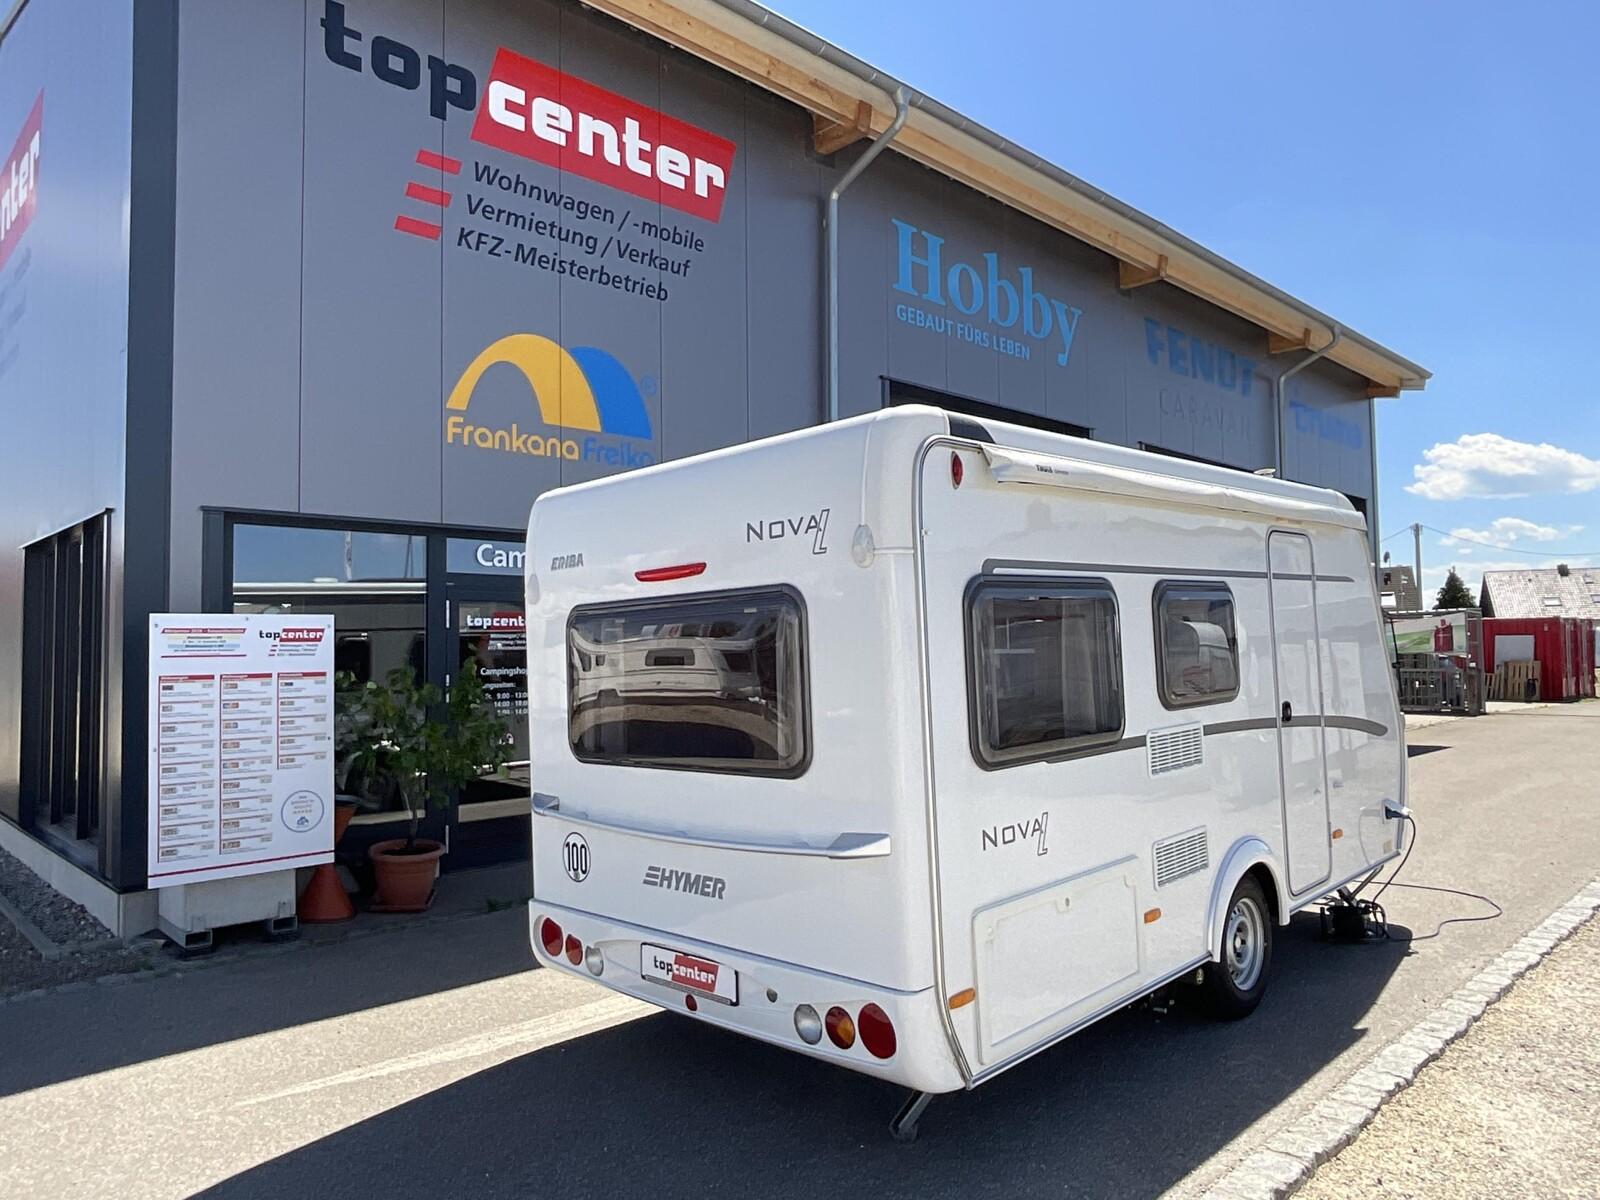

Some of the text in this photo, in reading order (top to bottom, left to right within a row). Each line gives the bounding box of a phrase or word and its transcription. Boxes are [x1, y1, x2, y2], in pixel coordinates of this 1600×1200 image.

[474, 161, 615, 224] Wohnwagen
[467, 194, 598, 254] Vermietung
[616, 239, 691, 277] Verkauf
[456, 227, 669, 302] KFZ-Meisterbetrieb
[891, 218, 1082, 367] Hobby
[896, 305, 1031, 361] GEBAUT FÜRS LEBEN
[1144, 317, 1257, 397] FENDT
[1159, 388, 1250, 436] CARAVAN
[550, 552, 584, 571] ERIBA
[480, 666, 528, 677] Campingsho
[565, 841, 588, 875] 100
[658, 867, 727, 900] HYMER
